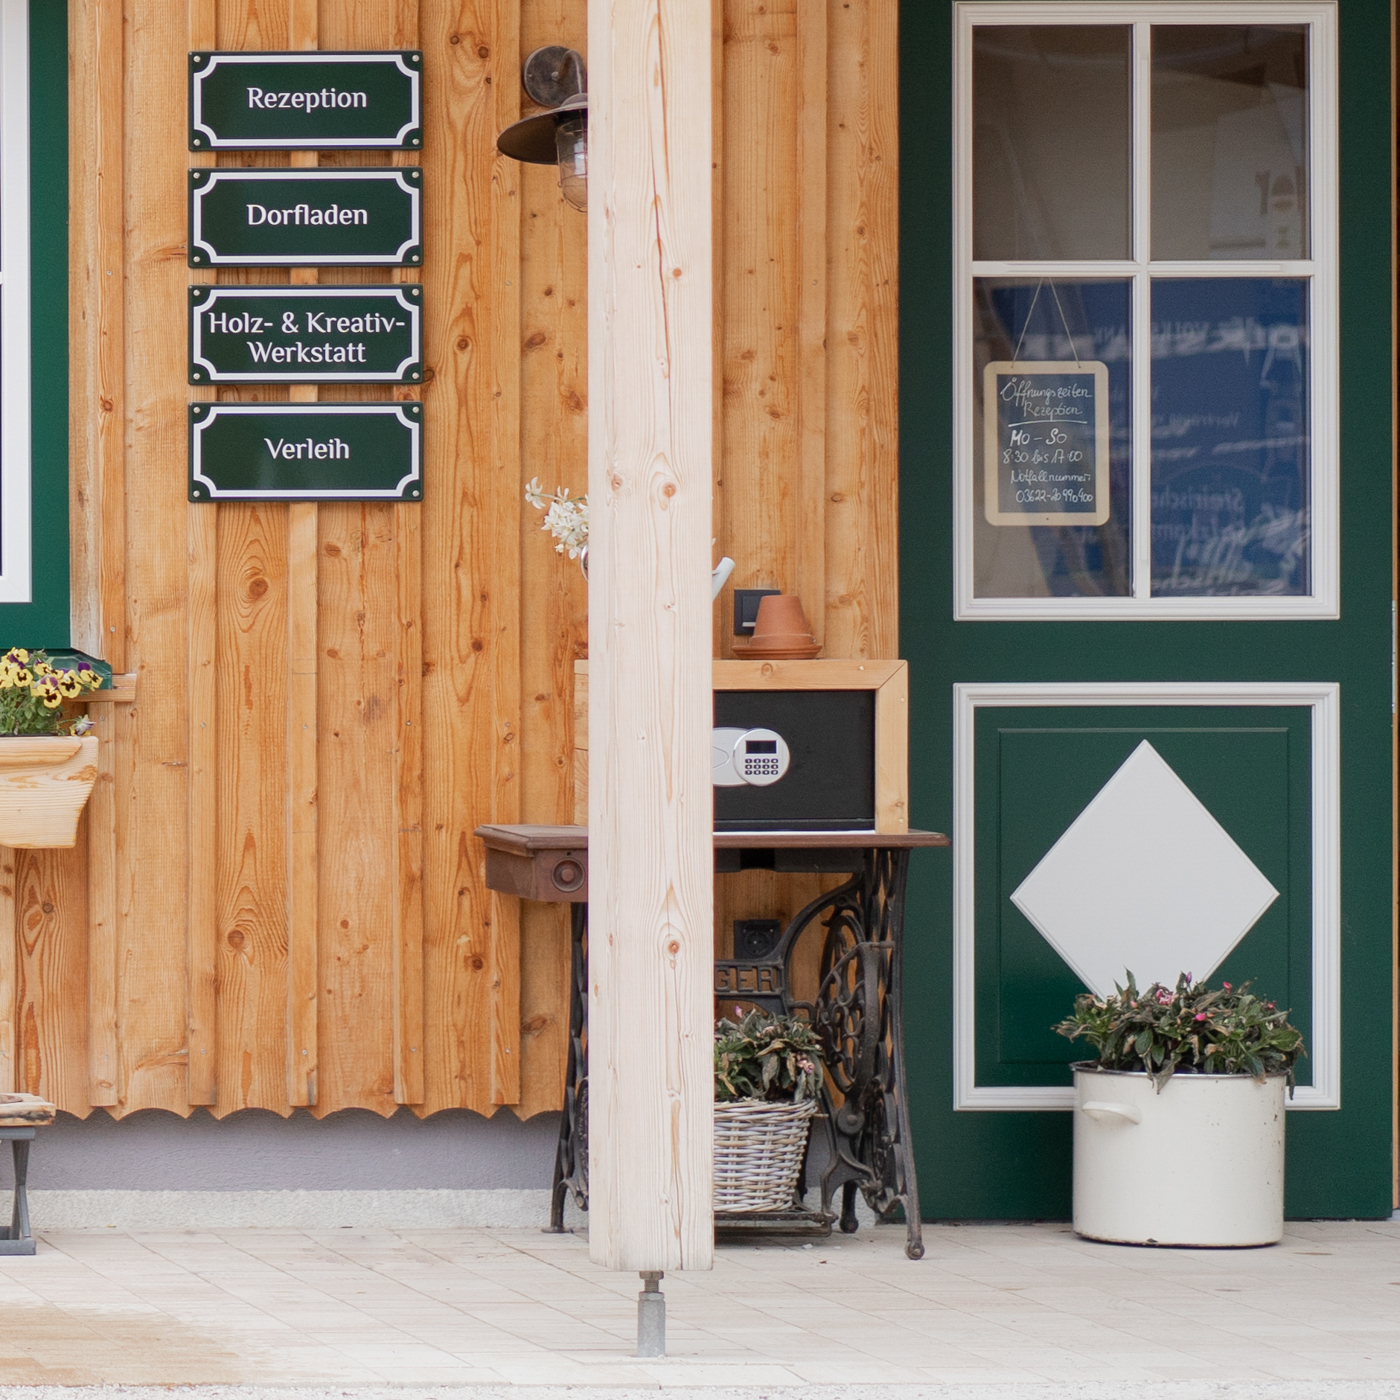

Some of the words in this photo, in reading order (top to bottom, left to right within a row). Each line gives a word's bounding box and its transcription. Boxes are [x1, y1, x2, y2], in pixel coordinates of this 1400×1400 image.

[246, 87, 368, 114] Rezeption
[246, 203, 369, 227] Dorfladen
[208, 311, 273, 334] Holz-
[281, 311, 299, 334] &
[306, 311, 406, 334] Kreativ-
[246, 341, 367, 364] Werkstatt
[999, 376, 1093, 407] Öffnungszeiten
[1023, 400, 1083, 421] Rezeption
[264, 437, 350, 461] Verleih
[1003, 448, 1029, 464] 8:30
[1031, 448, 1049, 465] bis
[714, 966, 774, 992] GER
